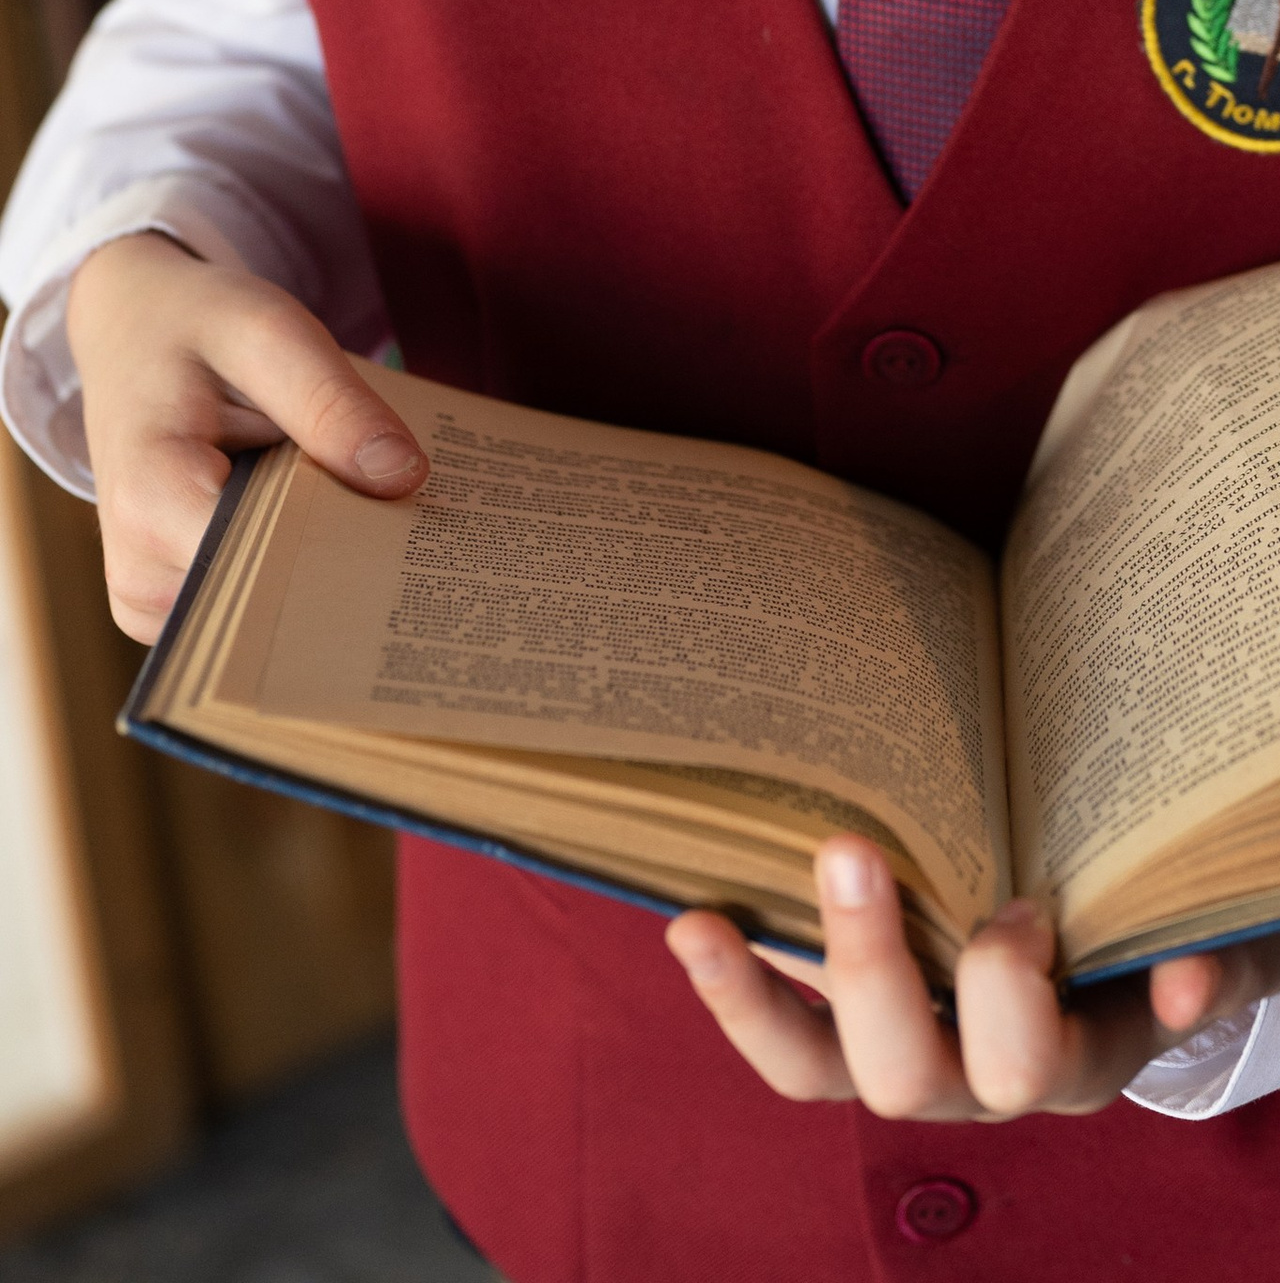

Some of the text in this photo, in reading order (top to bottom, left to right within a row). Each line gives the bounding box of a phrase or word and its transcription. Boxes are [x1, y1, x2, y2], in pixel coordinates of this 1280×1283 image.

[1171, 58, 1198, 90] г.
[1174, 475, 1229, 523] которая
[1201, 473, 1260, 519] процесс
[1226, 493, 1245, 509] их
[1253, 482, 1261, 490] с
[1146, 512, 1219, 574] обучением
[1177, 521, 1195, 538] их
[1222, 524, 1264, 554] часто
[1270, 526, 1280, 535] с
[1190, 537, 1261, 588] подбором
[1184, 587, 1237, 625] иногда
